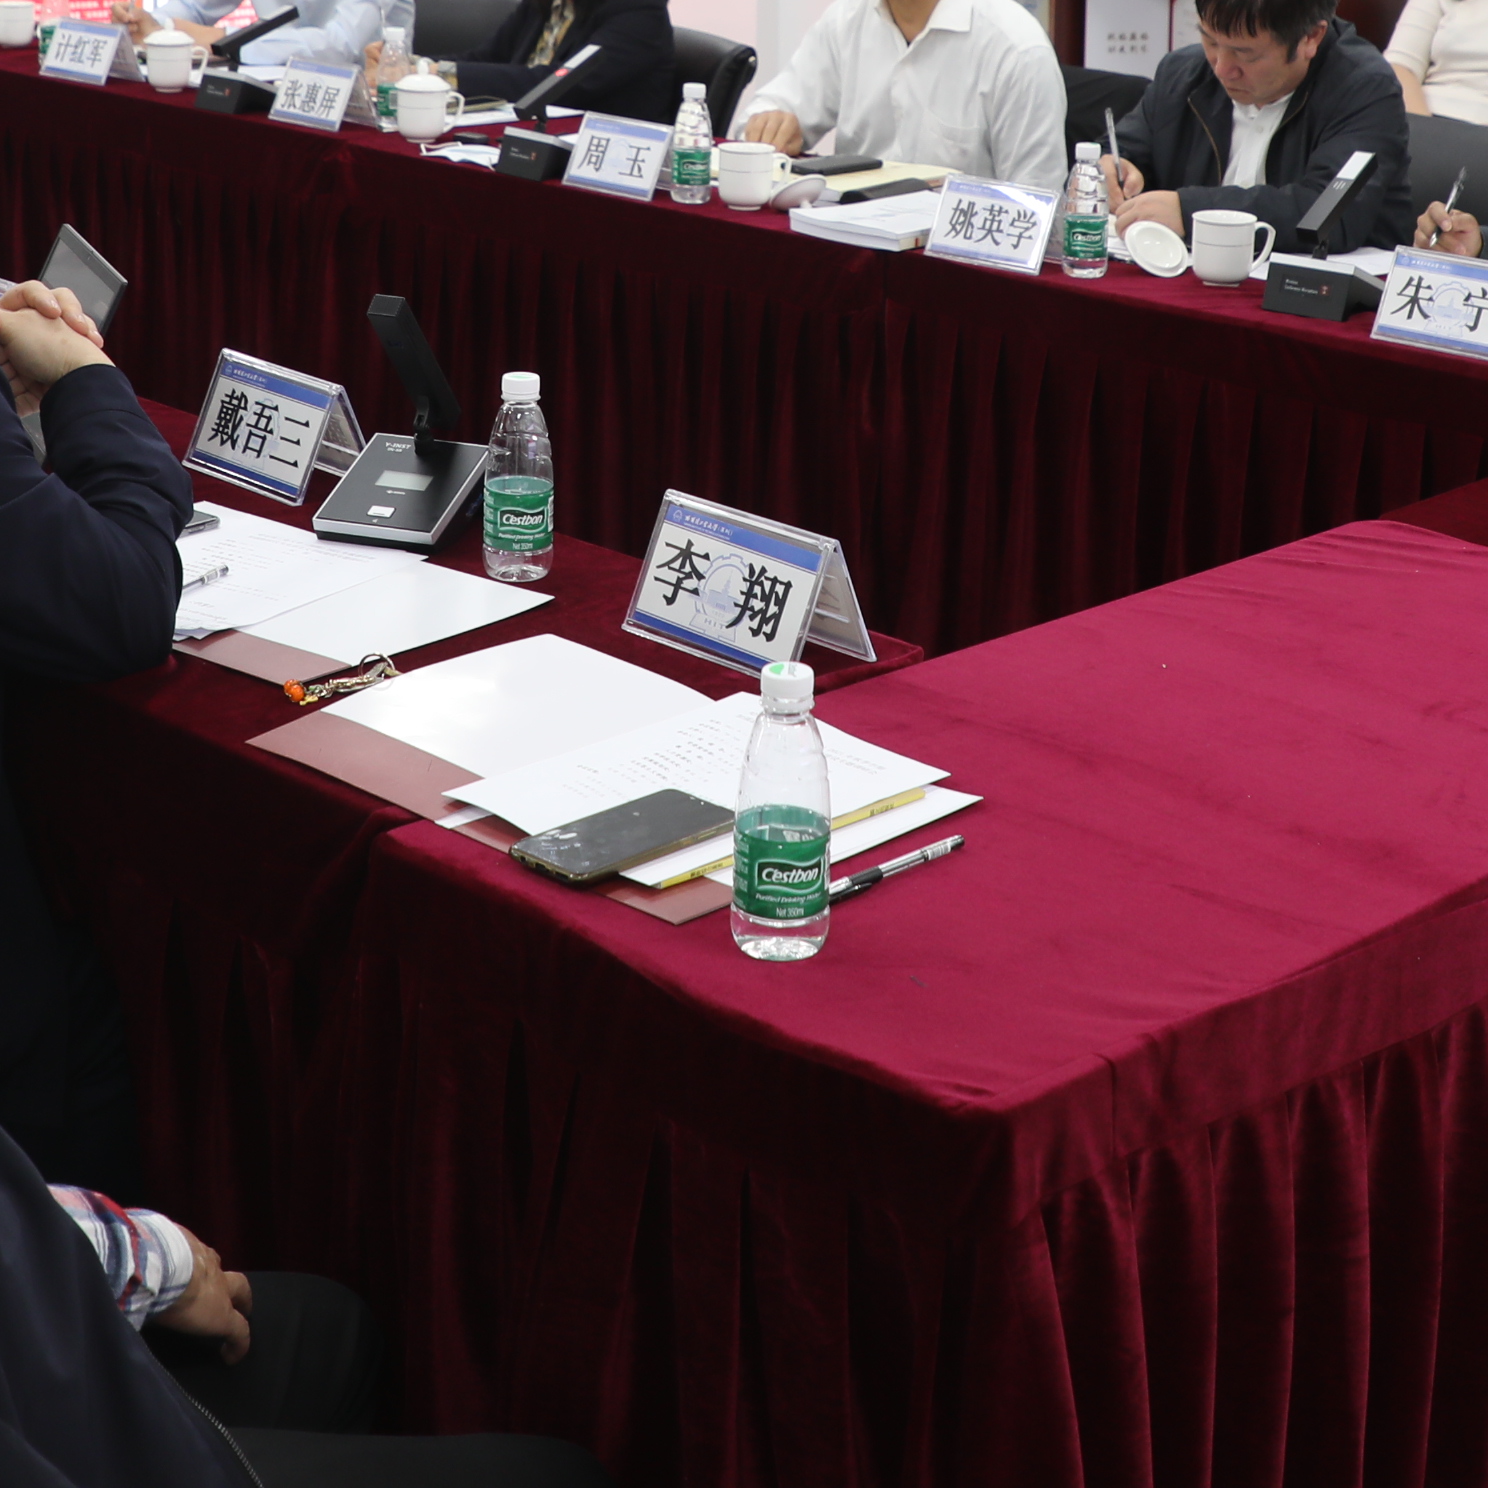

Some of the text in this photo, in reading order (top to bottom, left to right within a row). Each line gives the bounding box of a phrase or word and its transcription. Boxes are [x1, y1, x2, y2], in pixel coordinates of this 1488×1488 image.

[55, 33, 108, 68] 计红军
[280, 79, 341, 118] 张惠屏
[577, 135, 651, 179] 周玉
[943, 198, 1038, 250] 姚英学
[208, 388, 311, 469] 戴吾三
[653, 538, 794, 643] 李翔
